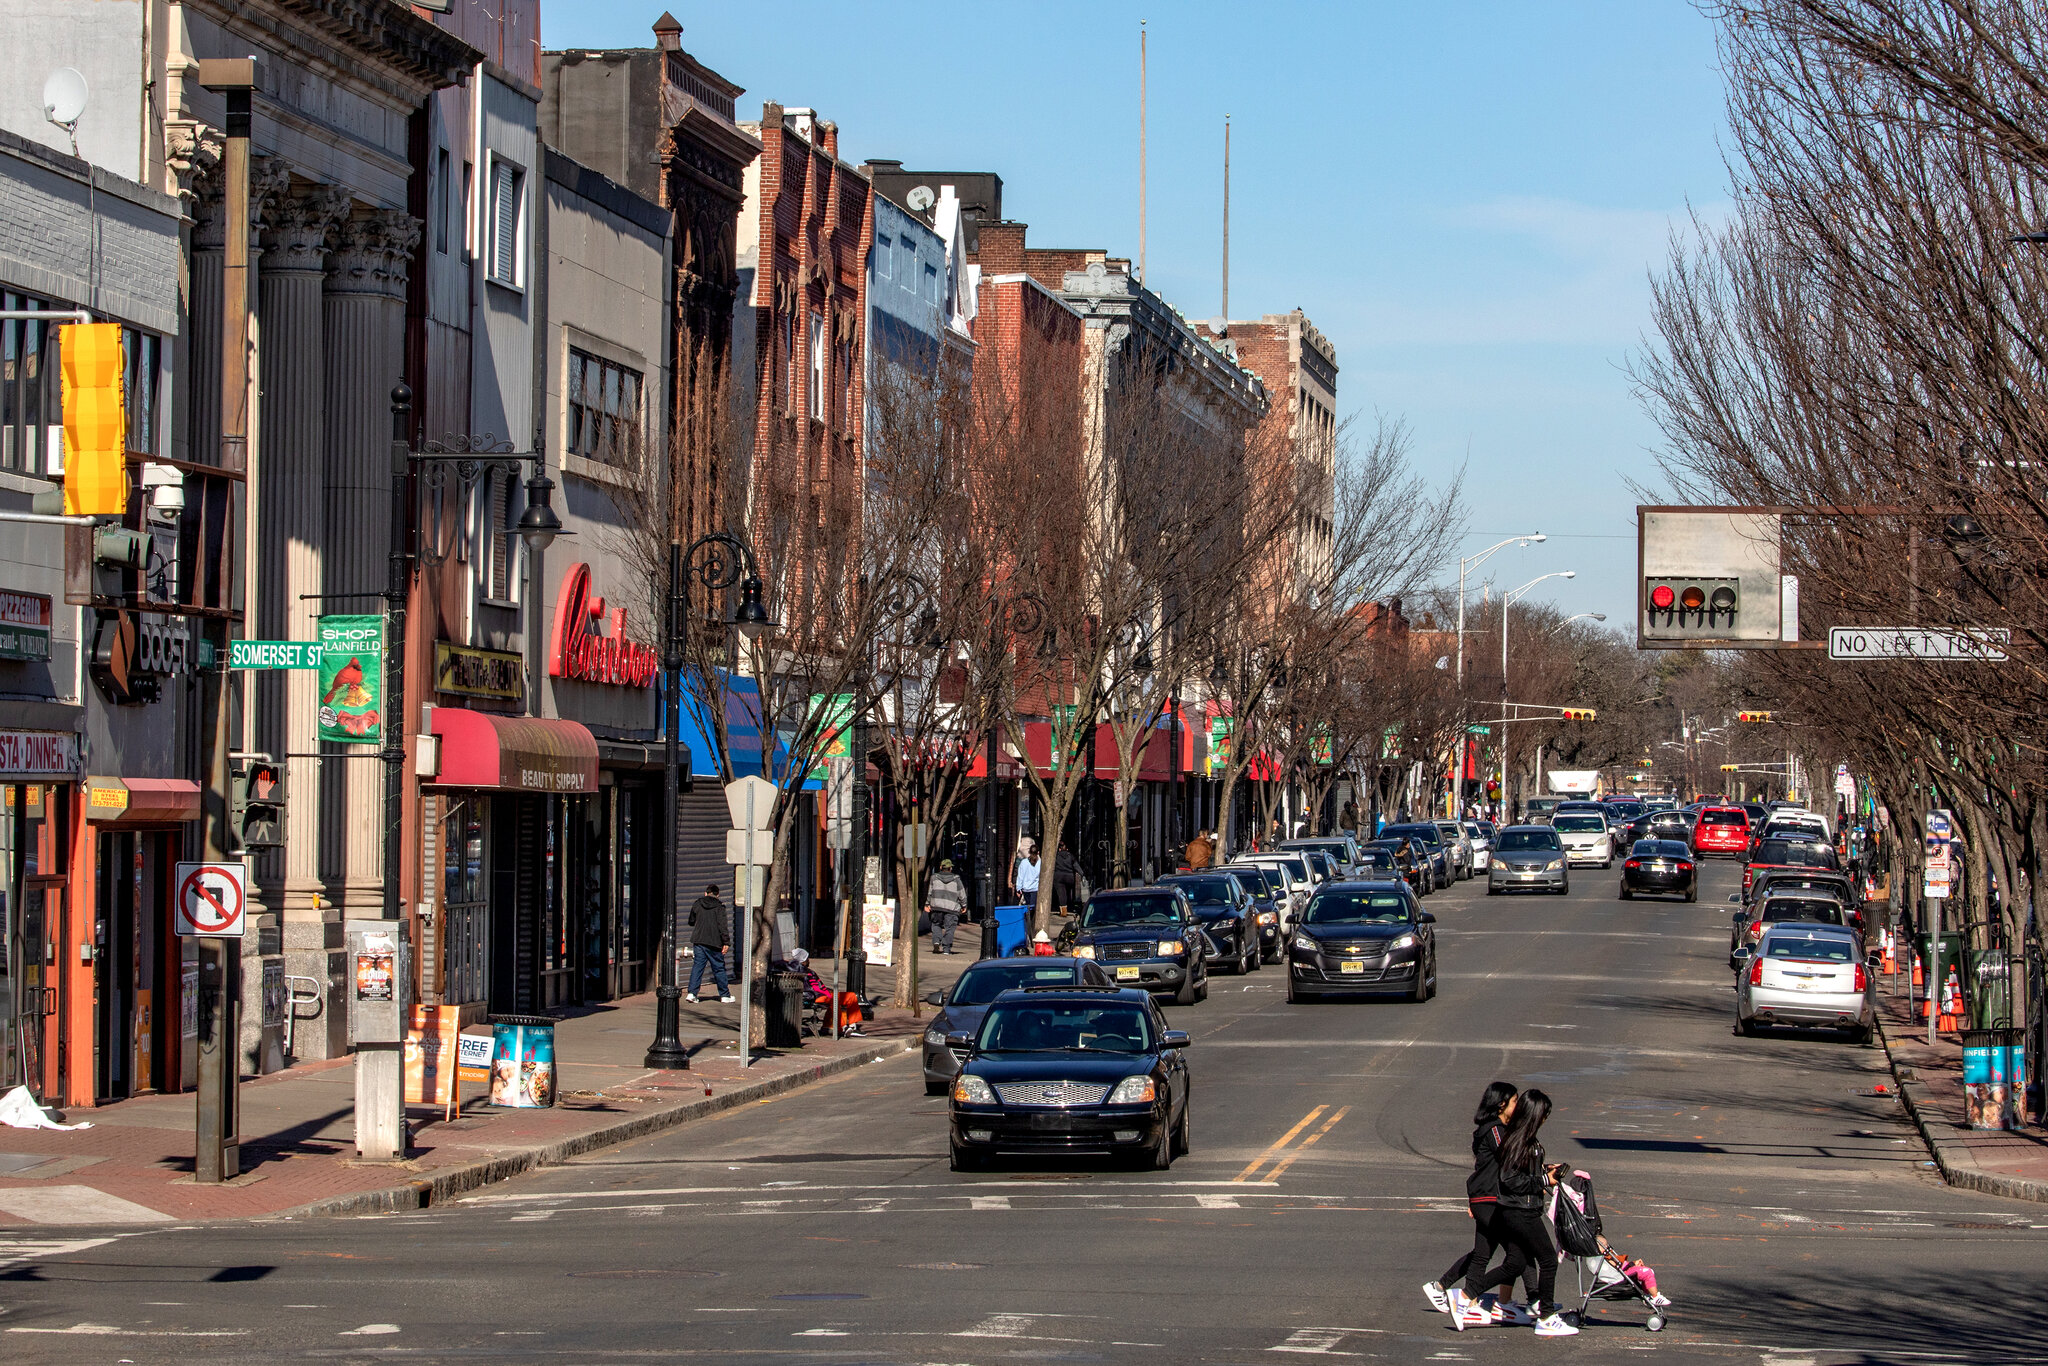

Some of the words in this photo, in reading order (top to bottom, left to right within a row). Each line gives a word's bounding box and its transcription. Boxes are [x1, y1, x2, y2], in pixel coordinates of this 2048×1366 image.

[0, 593, 40, 625] PIZZERIA
[322, 629, 378, 640] SHOP
[549, 563, 658, 688] Rainbow
[1839, 635, 1867, 652] NO
[1881, 635, 1932, 653] LEFT
[233, 644, 303, 666] SOMERSET
[307, 646, 324, 666] ST
[522, 769, 554, 788] BEAUTY
[556, 773, 585, 790] SUPPLY
